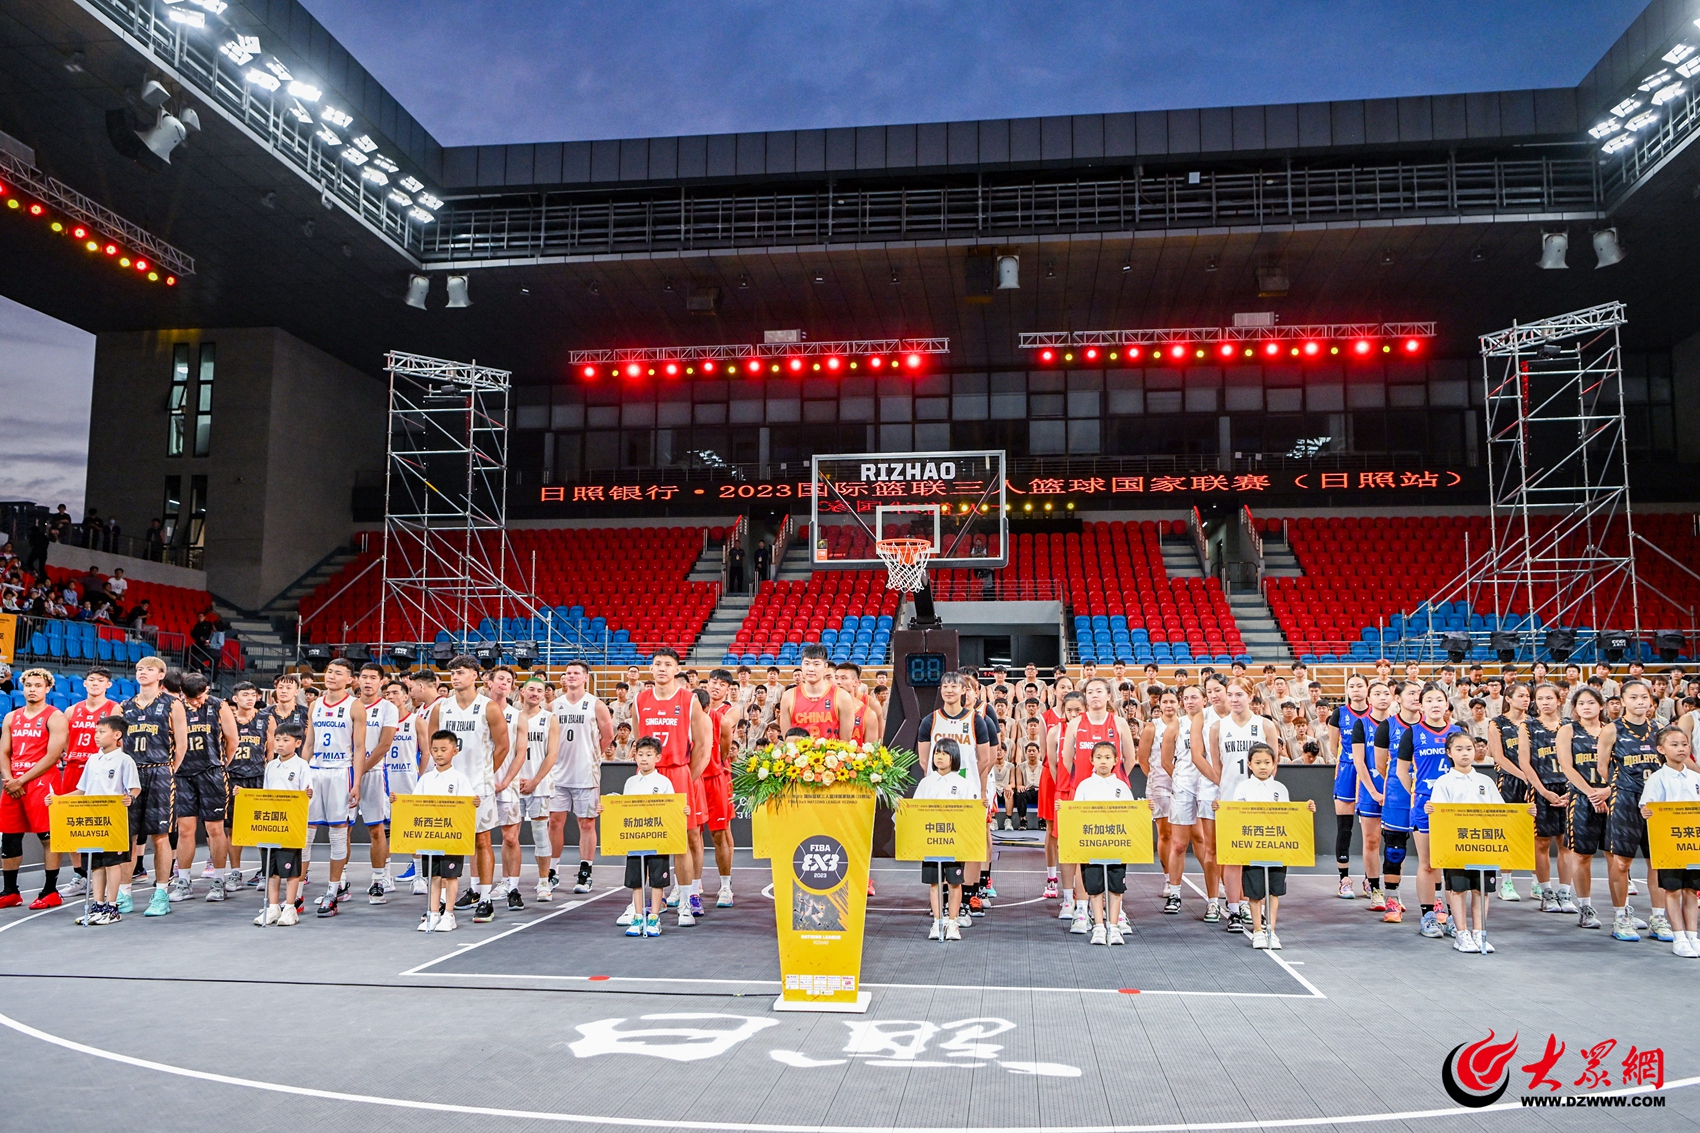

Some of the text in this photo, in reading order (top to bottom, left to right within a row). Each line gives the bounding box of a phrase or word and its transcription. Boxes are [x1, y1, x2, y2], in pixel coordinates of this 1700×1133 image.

[860, 461, 956, 481] RIZHAO
[645, 718, 678, 726] SINGAPORE
[794, 711, 833, 724] CHINA
[72, 721, 97, 729] JAPA
[313, 721, 346, 729] MONGOLIA
[12, 729, 41, 737] JAPAN
[567, 729, 574, 741] 0
[77, 733, 91, 746] 13
[134, 736, 147, 752] 10
[189, 736, 204, 751] 12
[323, 733, 332, 747] 3
[323, 752, 346, 760] MIAT
[391, 746, 399, 758] 6
[1438, 758, 1449, 774] 4
[253, 810, 288, 821] 蒙古国队
[66, 816, 112, 827] 马来西亚队
[413, 816, 453, 828] 新西兰队
[623, 816, 664, 828] 新加坡队
[251, 824, 289, 832] MONGOLIA
[925, 822, 957, 833] 中国队
[1082, 824, 1127, 835] 新加坡队
[1241, 825, 1288, 837] 新西兰队
[424, 831, 462, 840] ZEALAND
[619, 831, 668, 840] SINGAPORE
[1456, 827, 1506, 840] 蒙古国队
[926, 837, 955, 845] CHINA
[1079, 839, 1132, 847] SINGAPORE
[1231, 840, 1299, 849] NEW ZEALAND
[810, 844, 831, 852] FIBA
[1455, 844, 1509, 852] MONGOLIA
